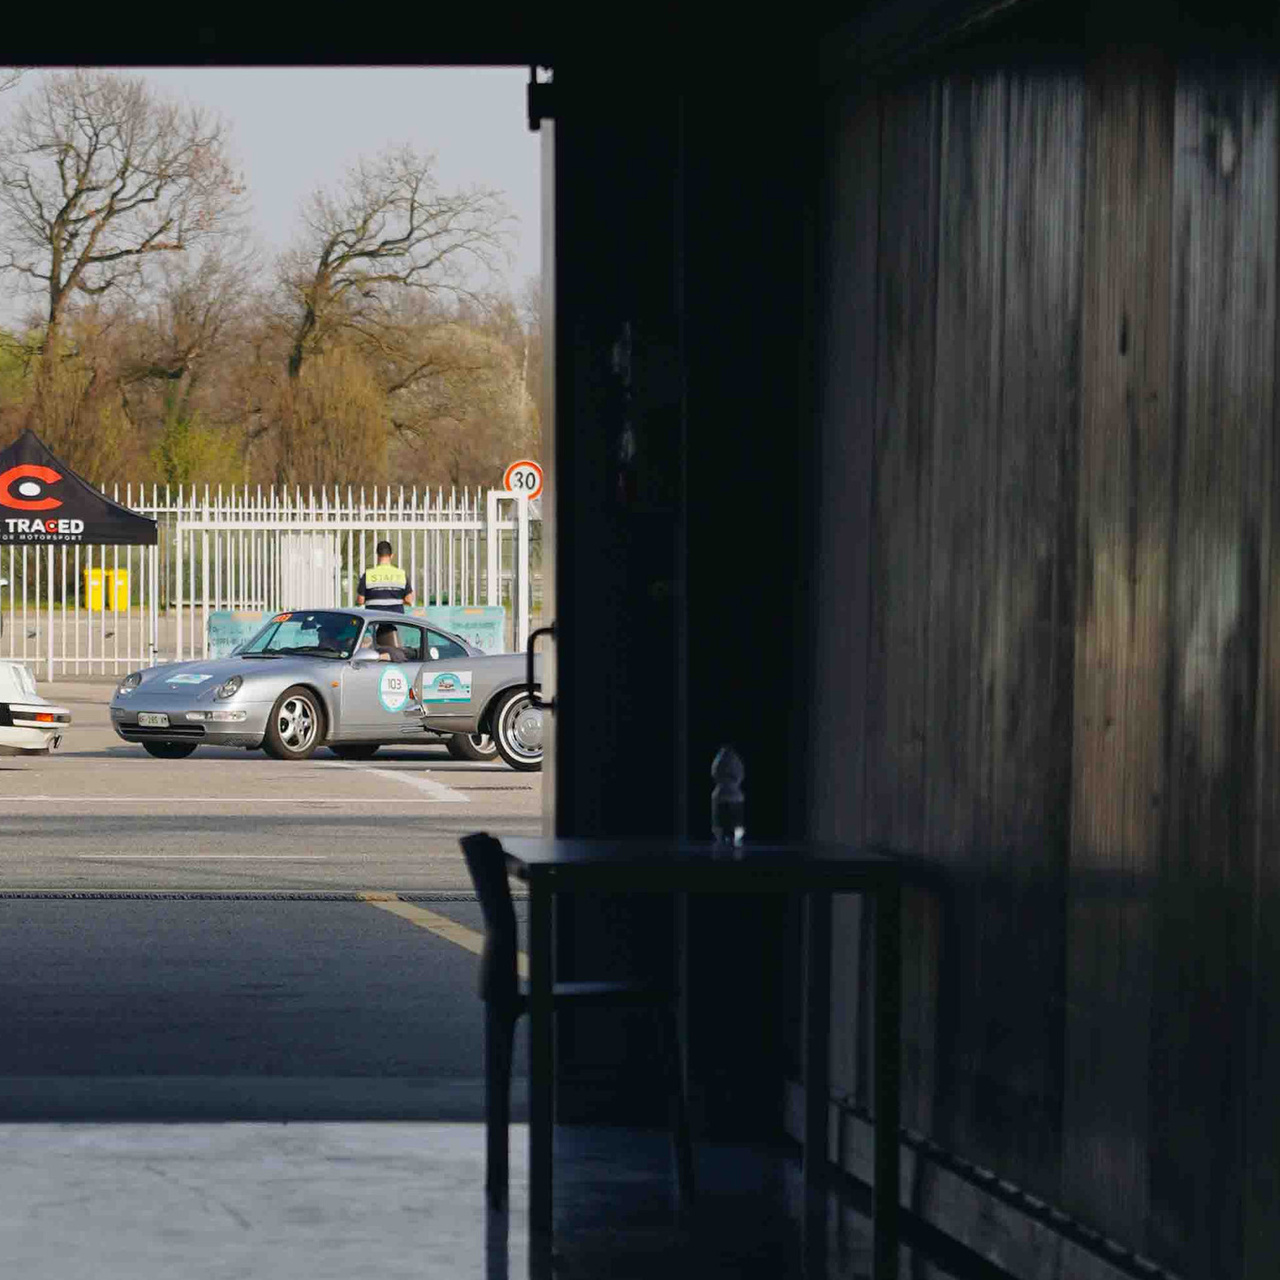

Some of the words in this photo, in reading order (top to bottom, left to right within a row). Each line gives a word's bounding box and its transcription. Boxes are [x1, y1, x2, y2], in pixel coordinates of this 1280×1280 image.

[514, 471, 536, 490] 30
[5, 519, 84, 534] TRACED
[387, 678, 402, 690] 103
